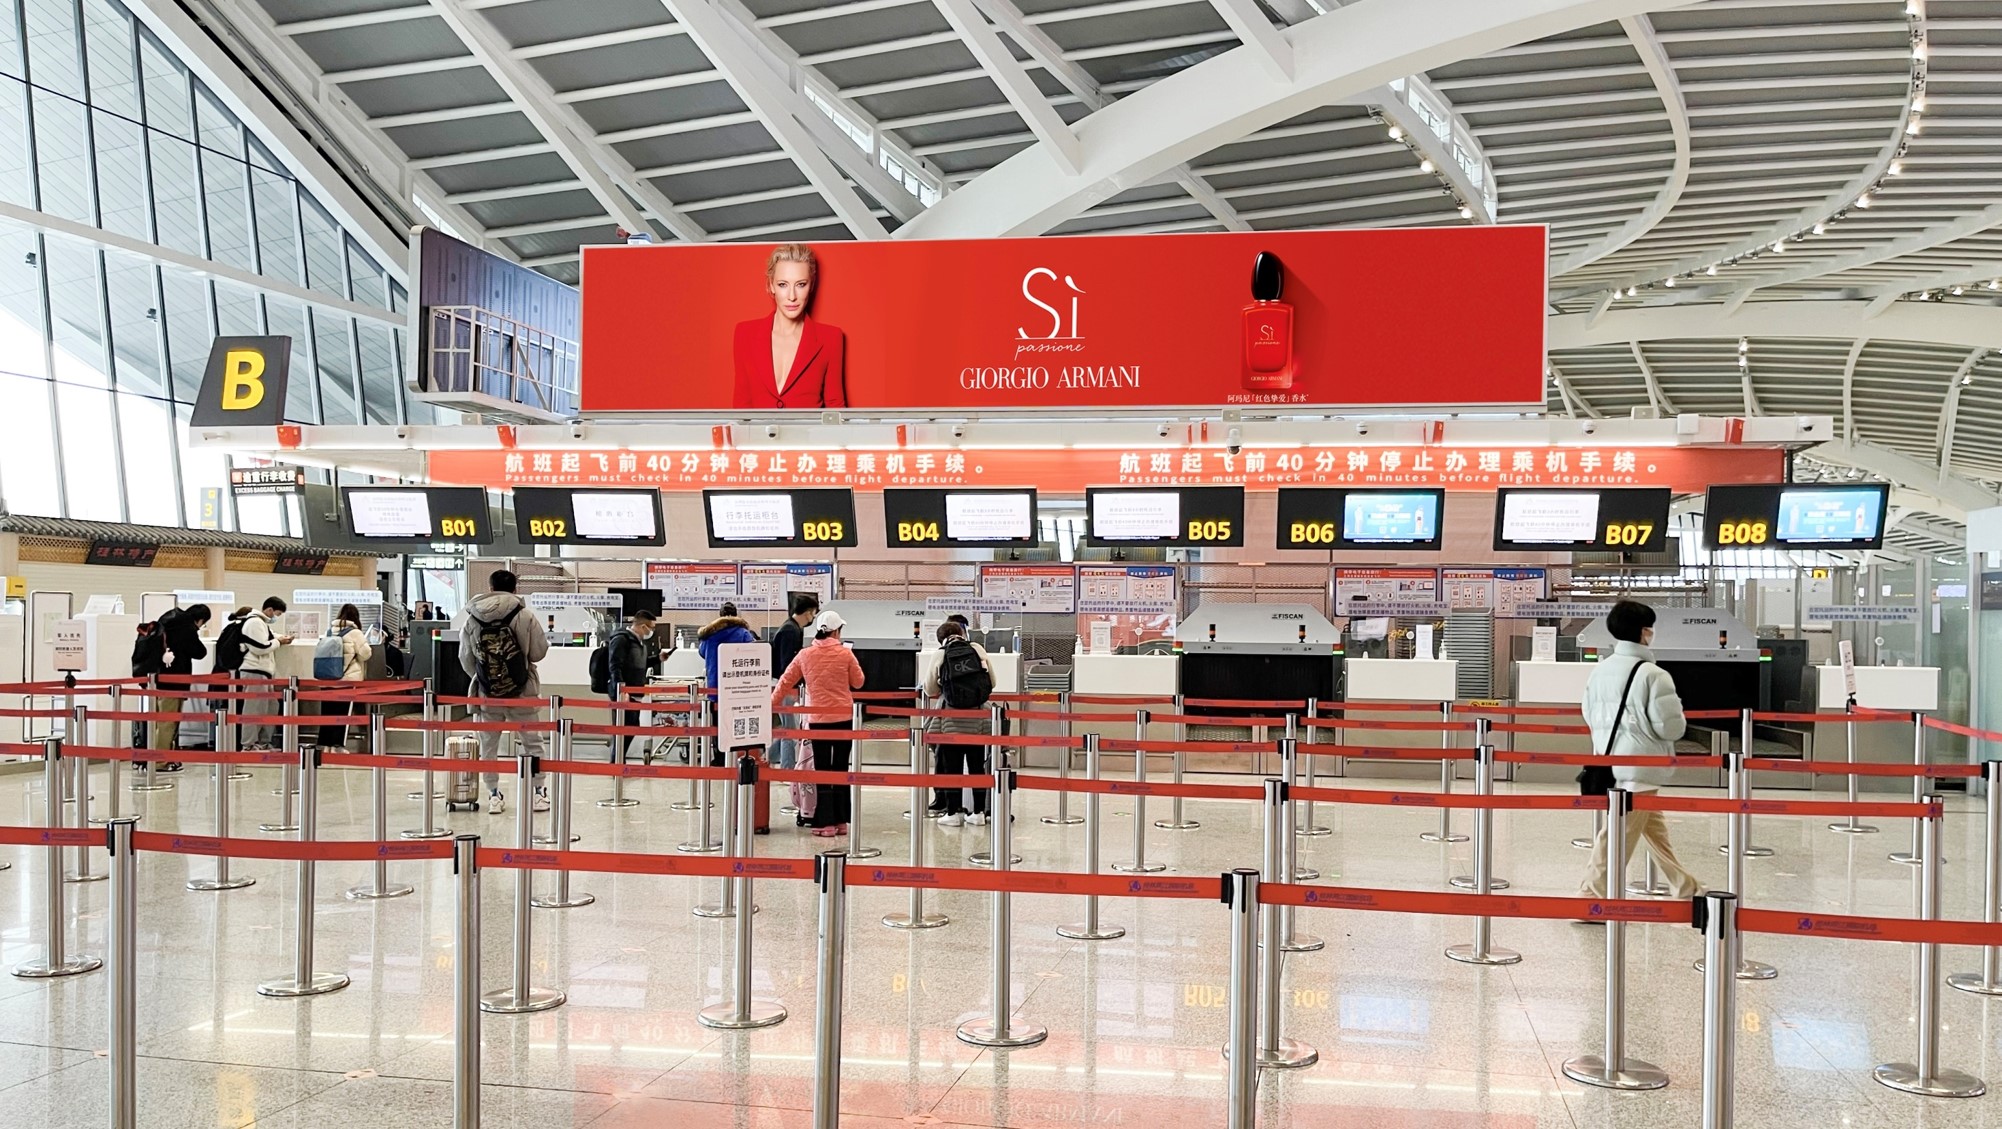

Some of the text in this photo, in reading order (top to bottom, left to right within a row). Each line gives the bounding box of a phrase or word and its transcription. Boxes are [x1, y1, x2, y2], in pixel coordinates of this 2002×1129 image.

[1017, 267, 1086, 338] Sì
[1014, 342, 1085, 361] passione
[222, 351, 265, 410] B
[960, 366, 1140, 389] GIORGIO ARMANI
[505, 473, 967, 484] Passengers must check in 40 minutes before flight departure.
[1120, 475, 1200, 484] Passengers
[1259, 473, 1300, 482] check
[1313, 473, 1326, 482] in
[1338, 474, 1353, 482] 40
[1366, 473, 1427, 482] minutes
[1440, 473, 1489, 482] before
[1500, 474, 1540, 484] flight
[1553, 474, 1638, 484] departure.
[442, 520, 475, 536] B01
[530, 520, 566, 537] B02
[803, 522, 842, 540] B03
[898, 522, 939, 541] B04
[1188, 522, 1231, 540] B05
[1291, 524, 1334, 543] B06
[1605, 525, 1652, 545] B07
[1718, 523, 1767, 544] B08
